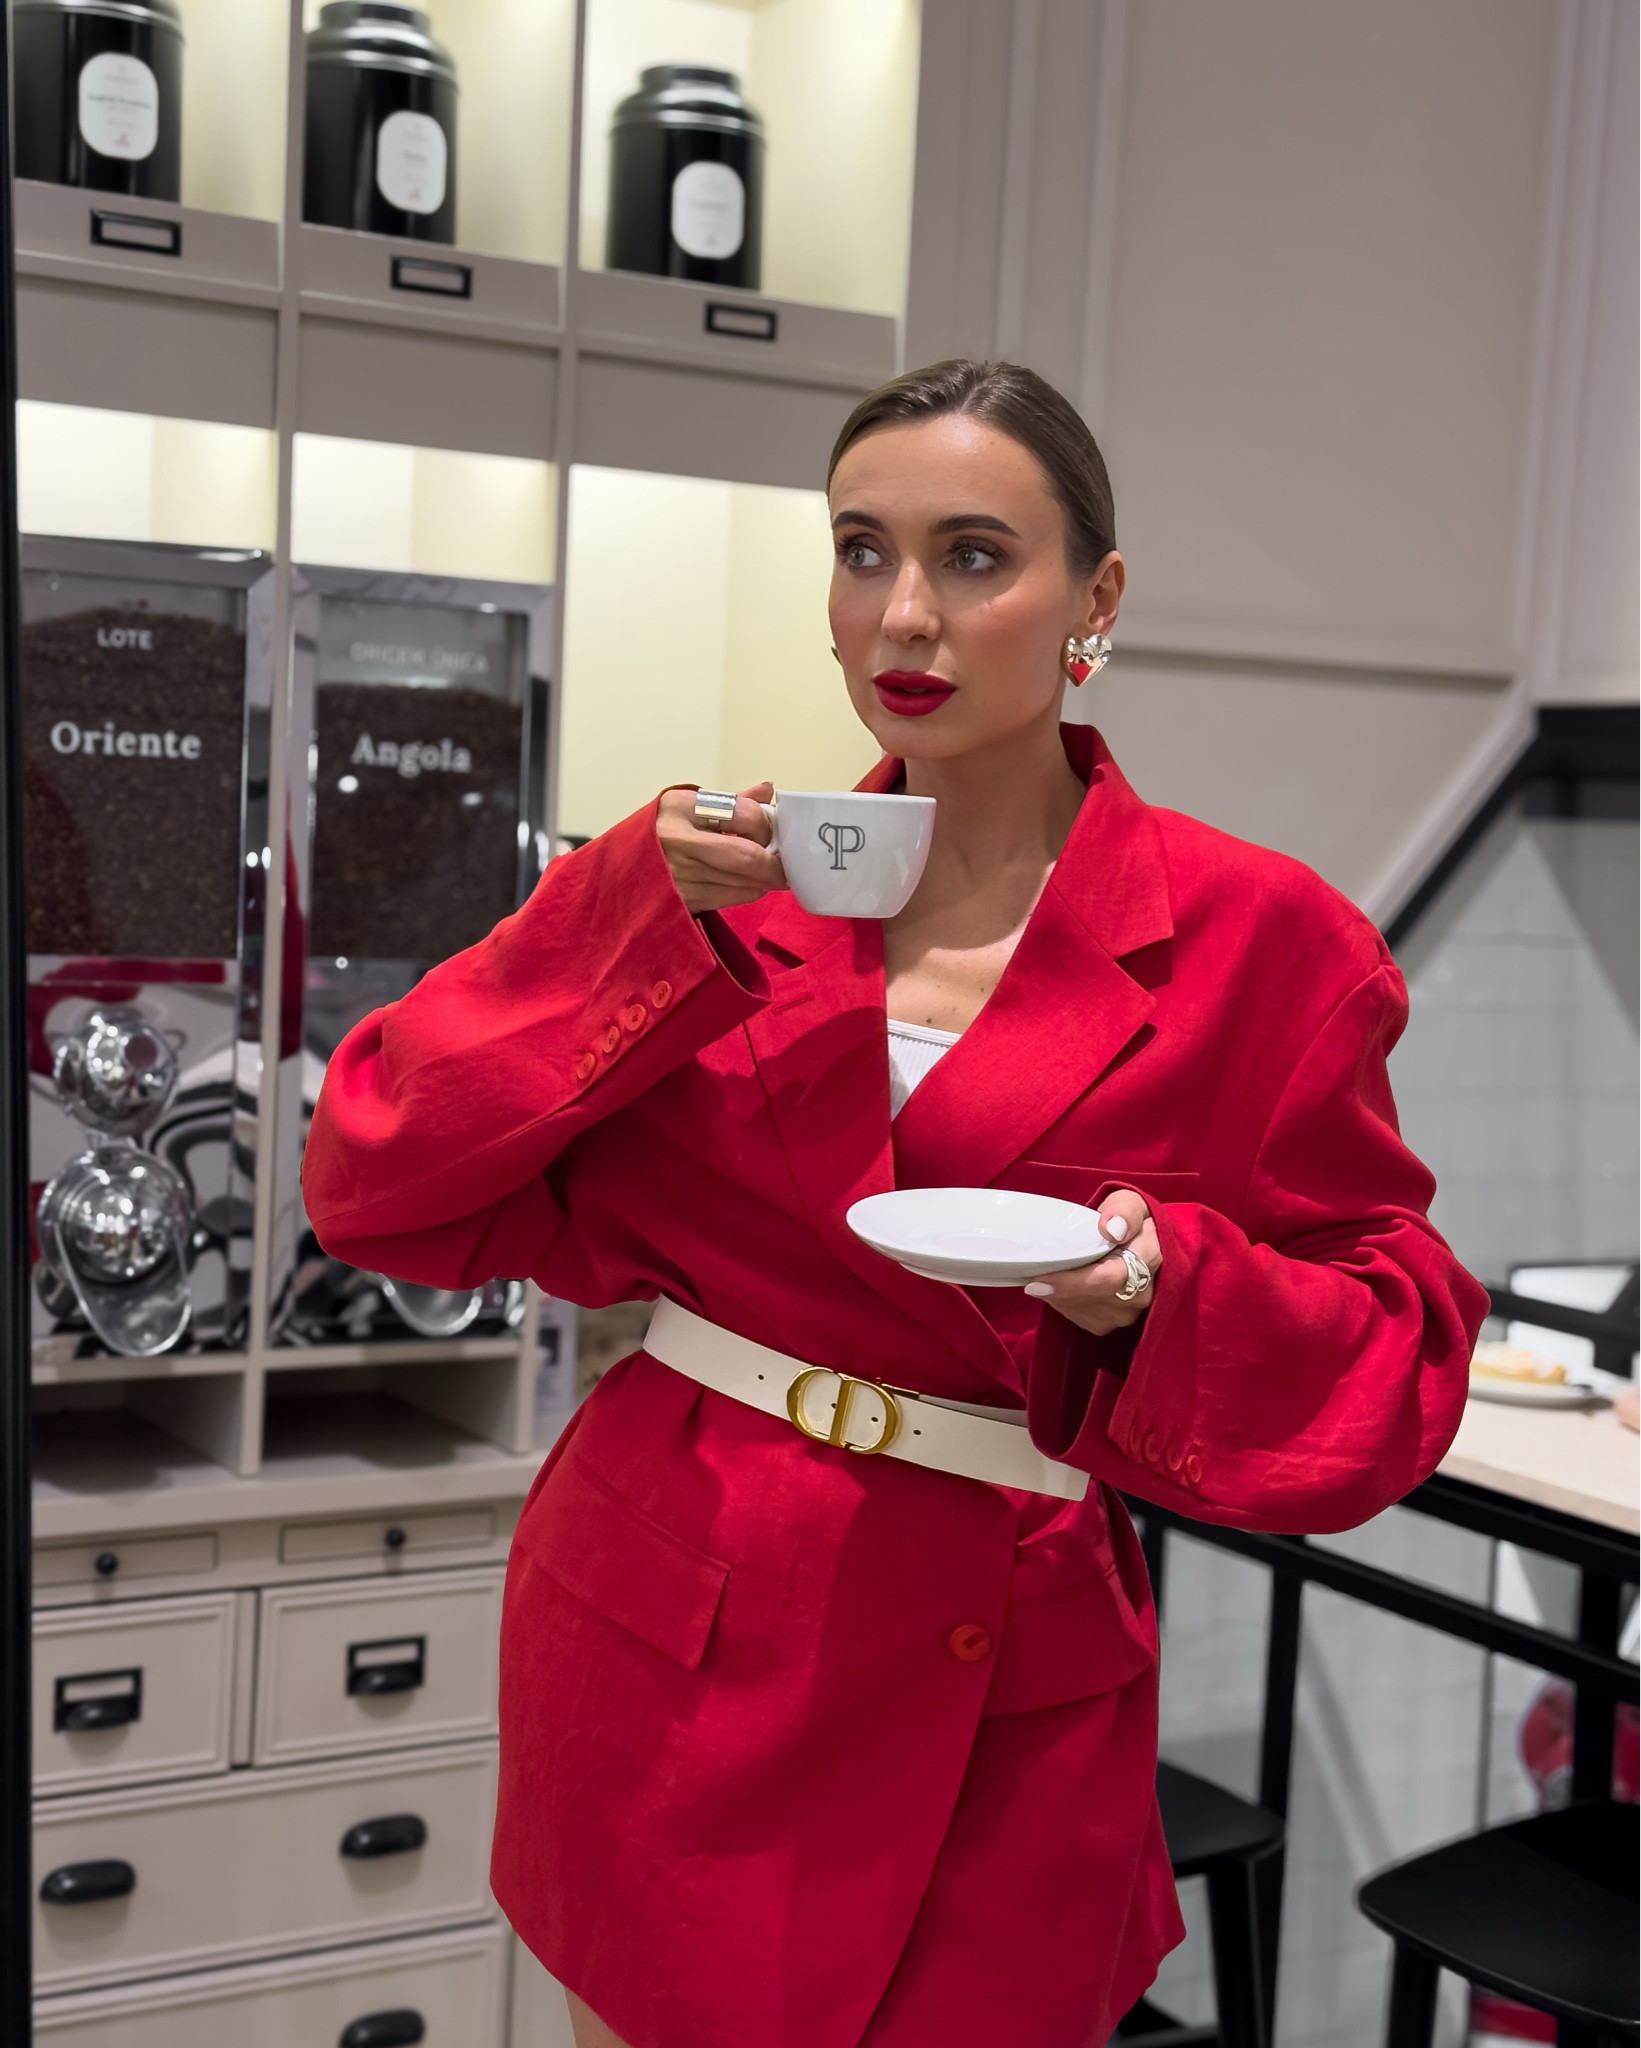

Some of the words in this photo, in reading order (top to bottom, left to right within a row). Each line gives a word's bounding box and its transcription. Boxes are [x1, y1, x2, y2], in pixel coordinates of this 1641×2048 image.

[97, 627, 154, 650] LOTE
[50, 720, 202, 760] Oriente
[351, 731, 472, 779] Angola
